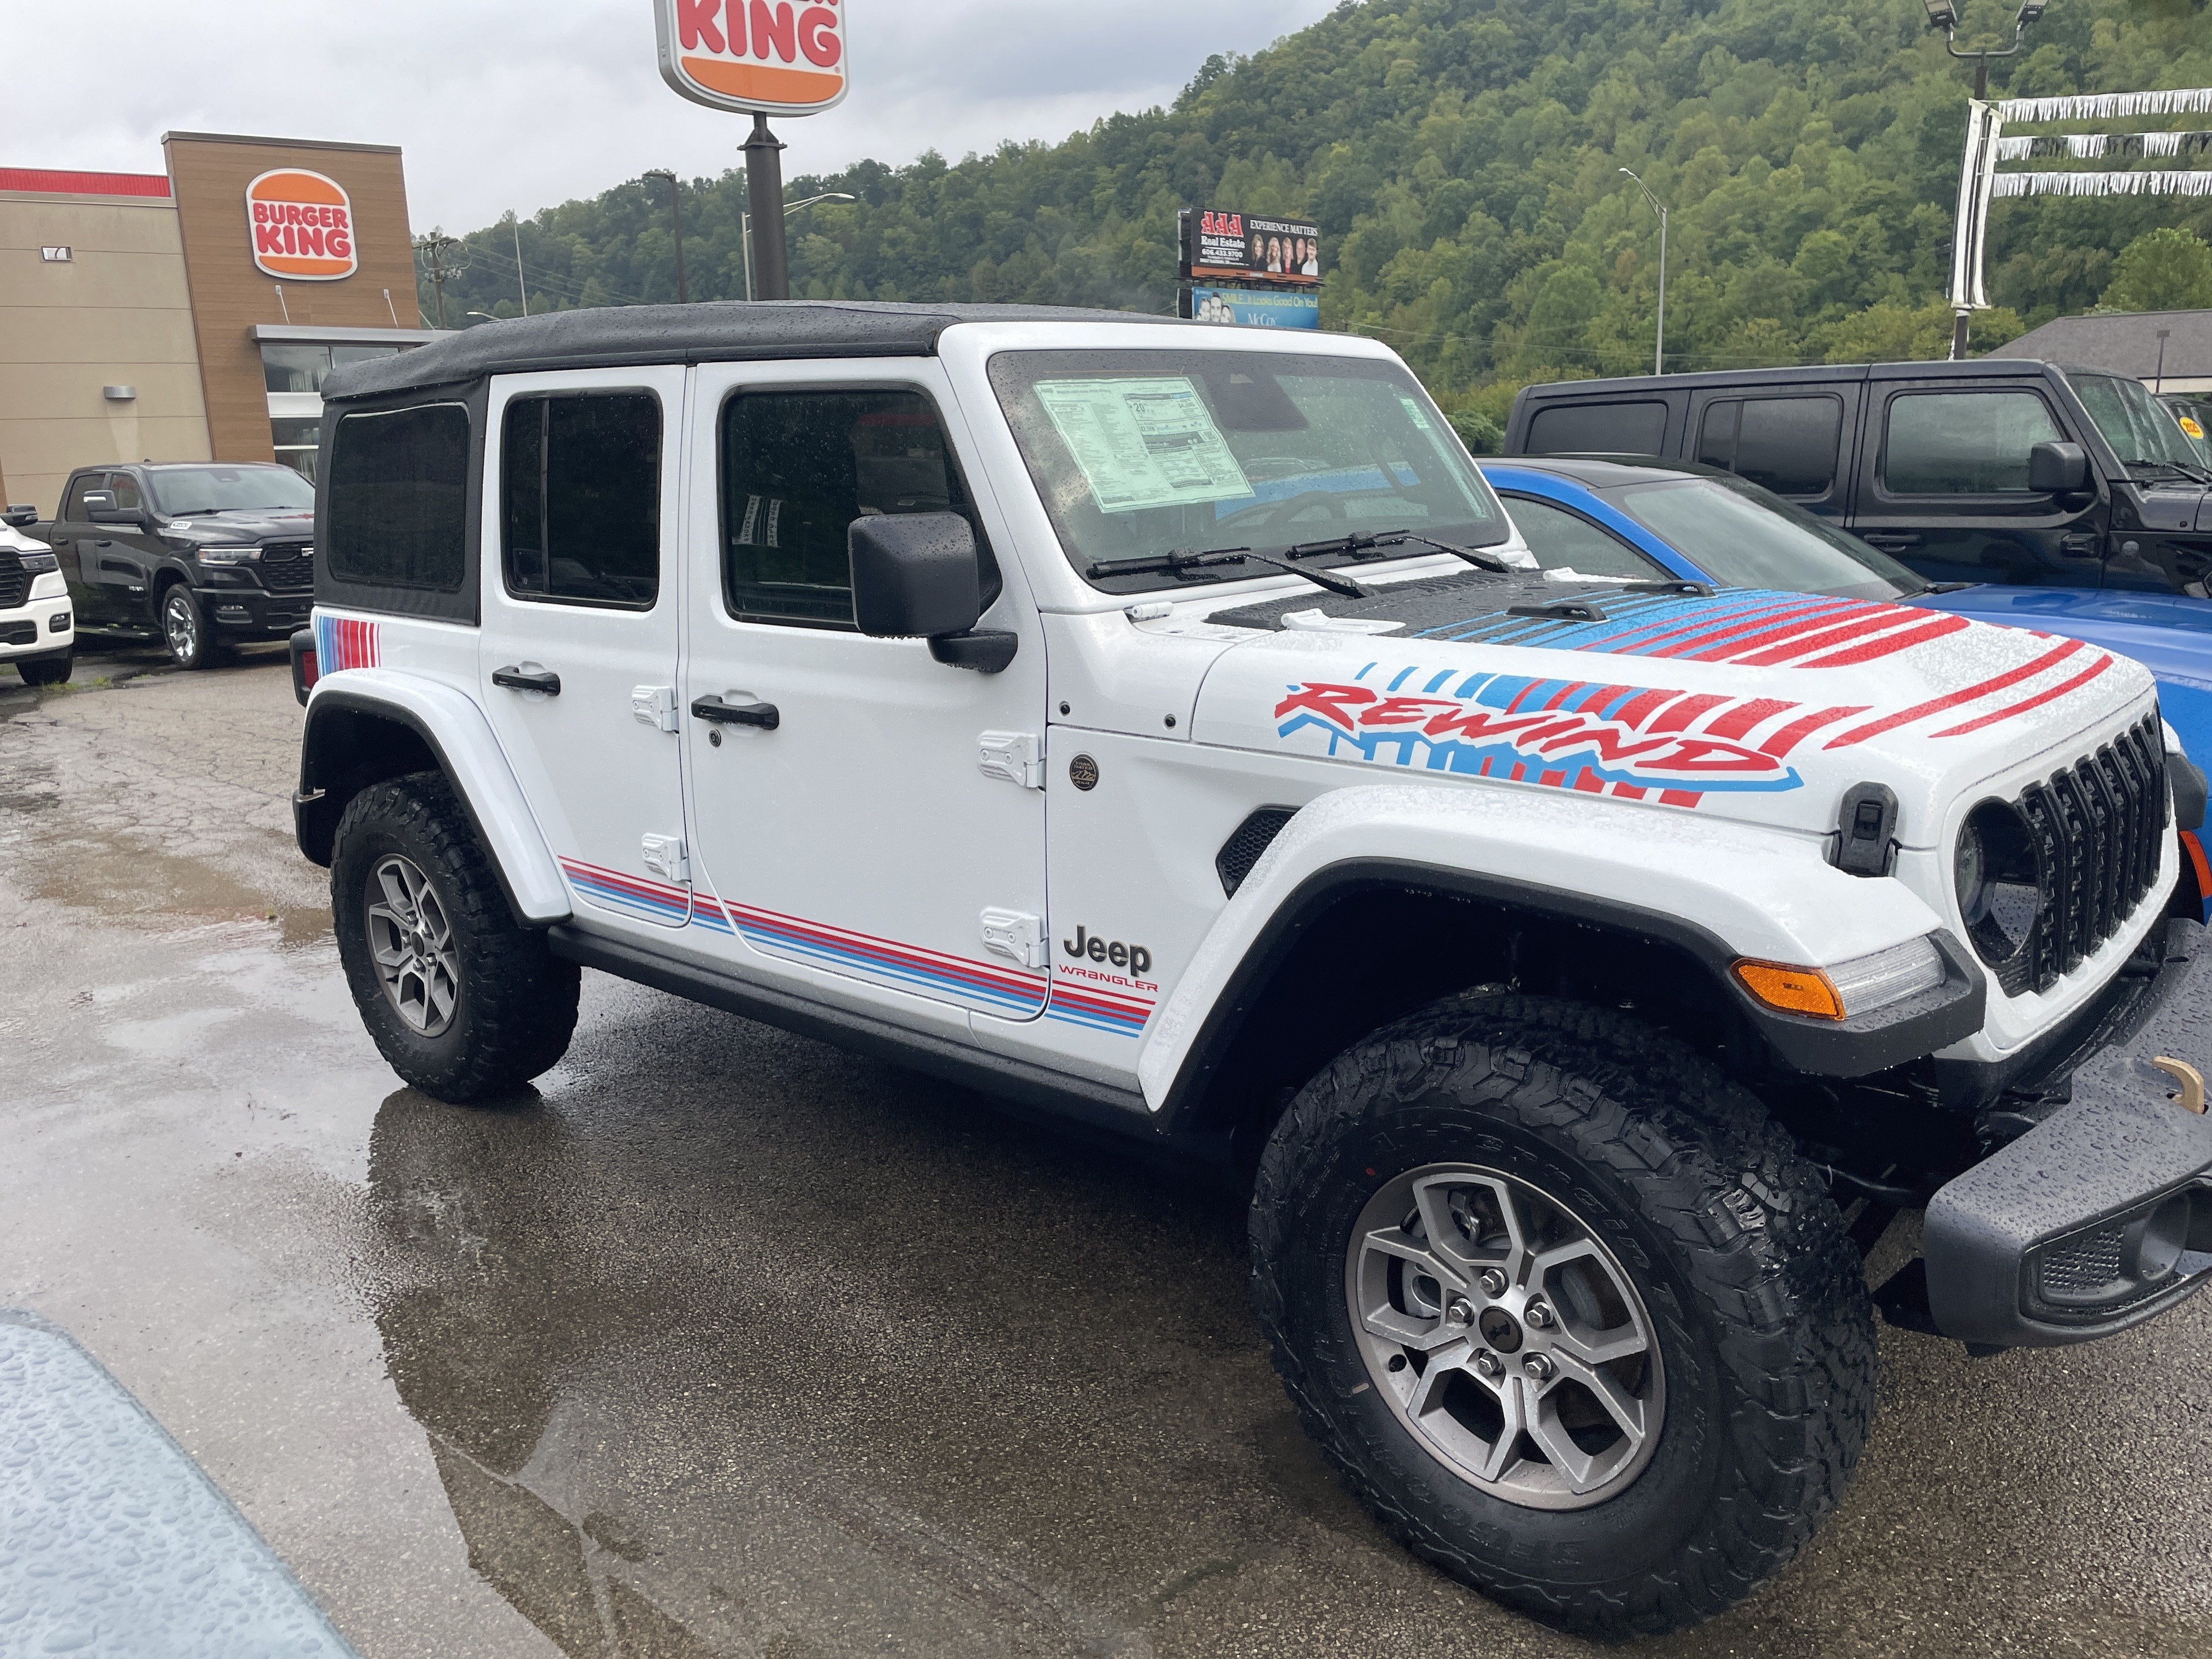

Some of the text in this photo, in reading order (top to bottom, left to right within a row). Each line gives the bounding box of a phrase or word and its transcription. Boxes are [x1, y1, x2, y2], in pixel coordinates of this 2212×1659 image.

[677, 0, 841, 67] KING
[253, 202, 348, 229] BURGER
[1200, 211, 1244, 238] AAA
[1250, 219, 1318, 236] EXPERIENCE MATTERS
[256, 224, 352, 258] KING
[1201, 236, 1245, 248] Real Estate
[1253, 295, 1272, 306] Looks
[1273, 295, 1293, 307] Good
[1293, 296, 1304, 307] On
[1276, 682, 1781, 771] REWIND
[1063, 924, 1152, 977] Jeep
[1059, 964, 1158, 992] WRANGLER
